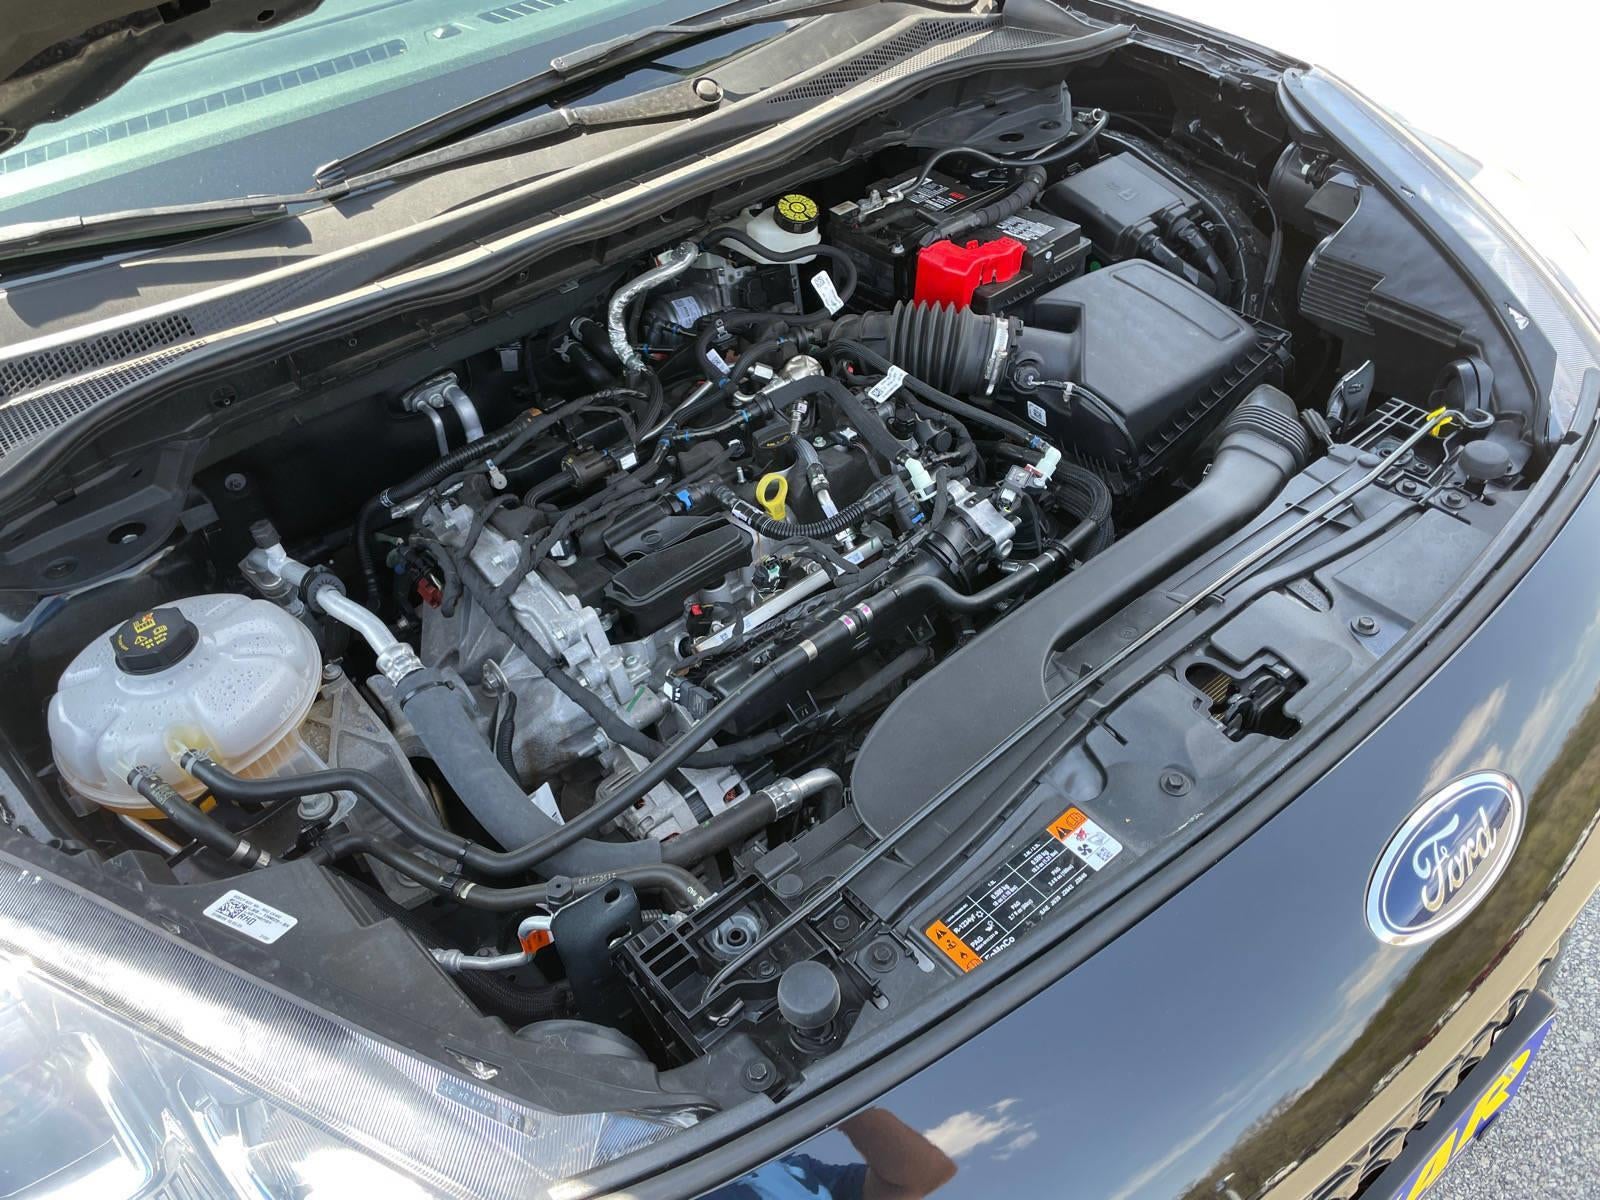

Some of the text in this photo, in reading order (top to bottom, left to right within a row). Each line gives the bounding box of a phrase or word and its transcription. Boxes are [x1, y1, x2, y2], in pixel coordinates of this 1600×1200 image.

[1412, 806, 1497, 912] Ford
[953, 913, 976, 934] R-1234yf
[970, 935, 984, 948] PAG
